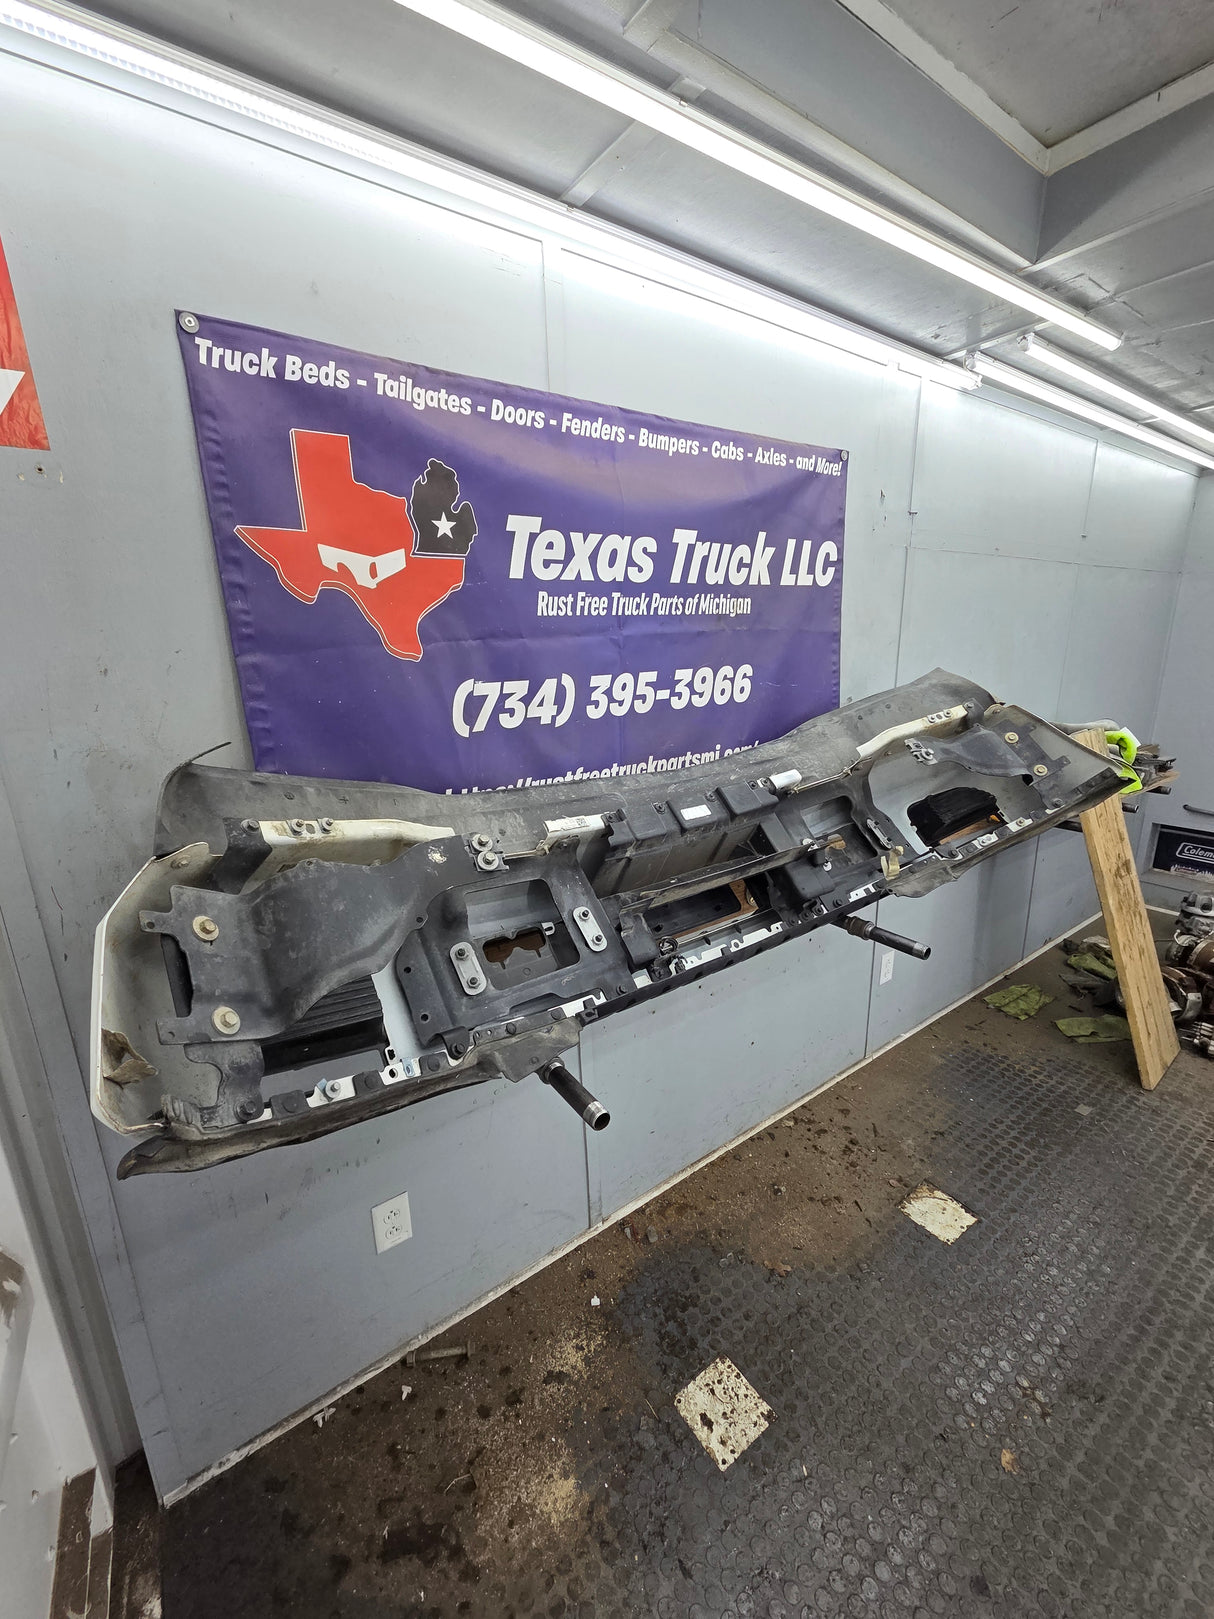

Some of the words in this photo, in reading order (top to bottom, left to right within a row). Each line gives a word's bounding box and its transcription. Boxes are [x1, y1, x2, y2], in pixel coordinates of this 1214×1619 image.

[194, 336, 276, 379] Truck
[285, 355, 349, 388] Beds
[356, 378, 367, 387] -
[373, 372, 472, 415] Tailgates
[476, 405, 486, 413] -
[491, 399, 545, 428] Doors
[562, 413, 625, 443] Fenders
[639, 428, 699, 456] Bumpers
[712, 441, 744, 461] Cabs
[755, 447, 786, 466] Axles
[796, 455, 815, 471] and
[815, 457, 842, 477] More!
[506, 515, 657, 583] Texas
[670, 529, 776, 585] Truck
[780, 539, 837, 586] LLC
[537, 591, 573, 616] Rust
[576, 592, 608, 616] Free
[612, 592, 649, 615] Truck
[650, 593, 683, 615] Parts
[685, 594, 700, 615] of
[699, 594, 751, 617] Michigan
[453, 673, 575, 737] (734)
[587, 664, 753, 719] 395-3966
[1184, 845, 1214, 858] Colem
